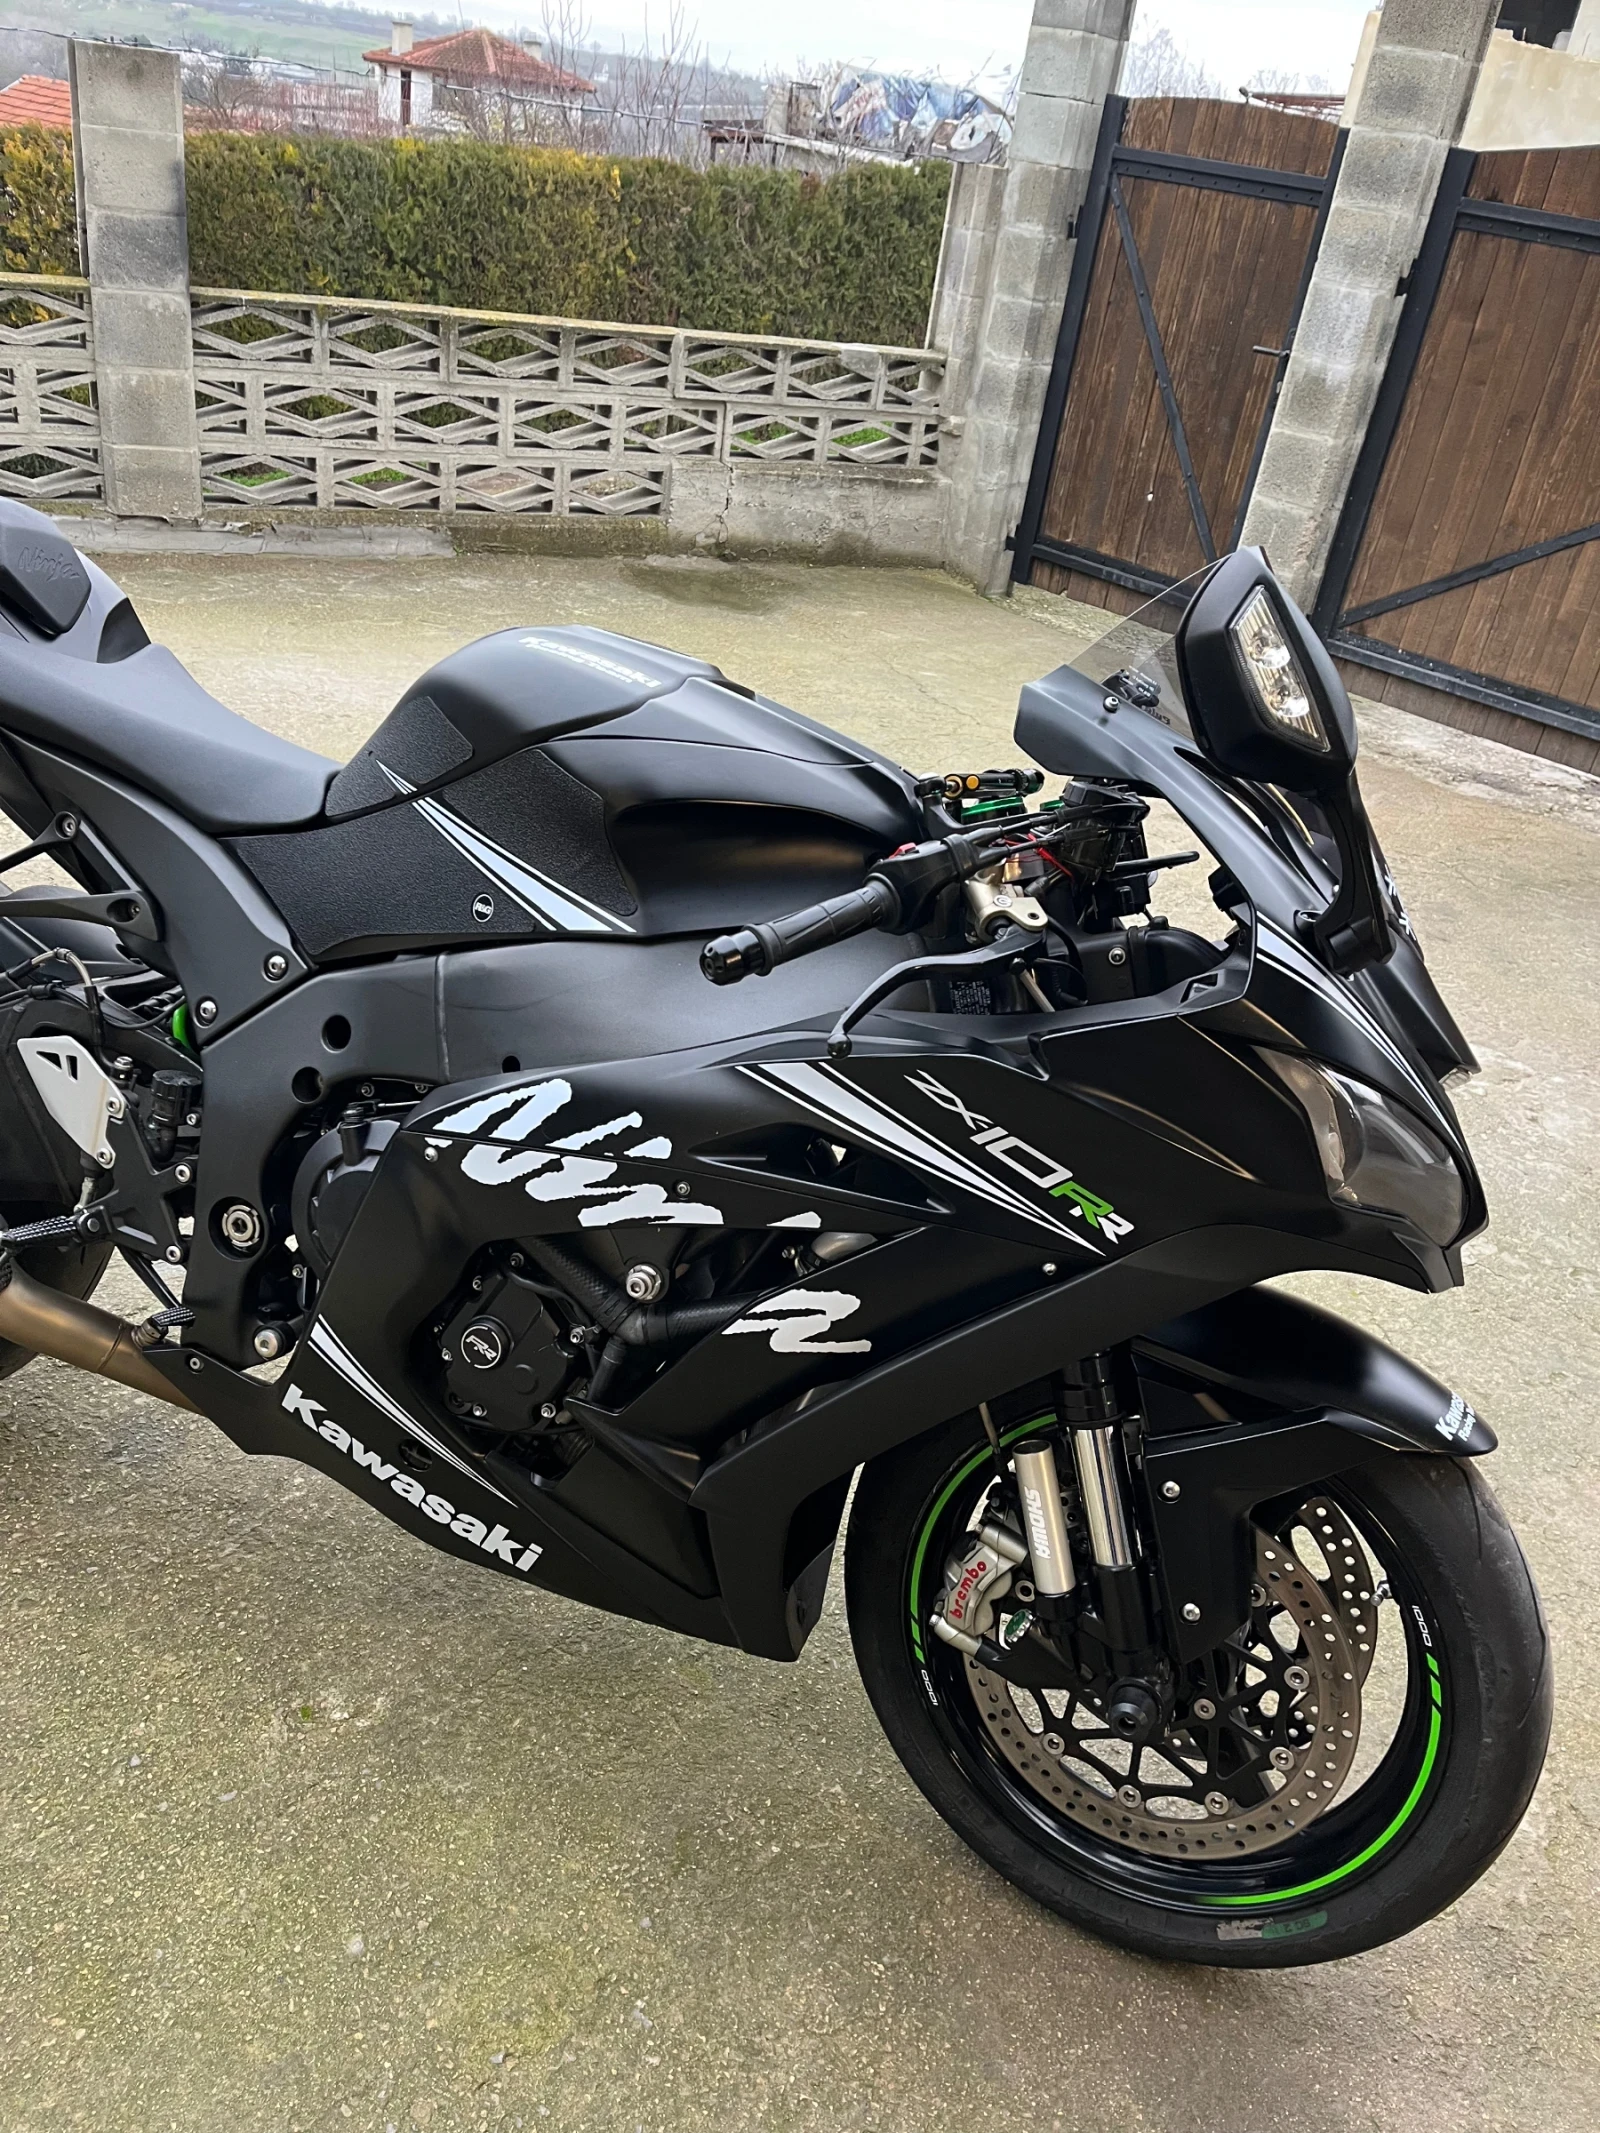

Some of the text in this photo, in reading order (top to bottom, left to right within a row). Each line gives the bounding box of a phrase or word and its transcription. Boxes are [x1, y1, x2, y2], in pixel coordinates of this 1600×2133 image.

[17, 546, 80, 581] Ninja
[281, 1383, 543, 1572] Kawasaki
[1024, 1486, 1052, 1559] SHOWA
[949, 1561, 987, 1619] brembo
[1411, 1604, 1433, 1647] 1000
[920, 1669, 939, 1706] 1000
